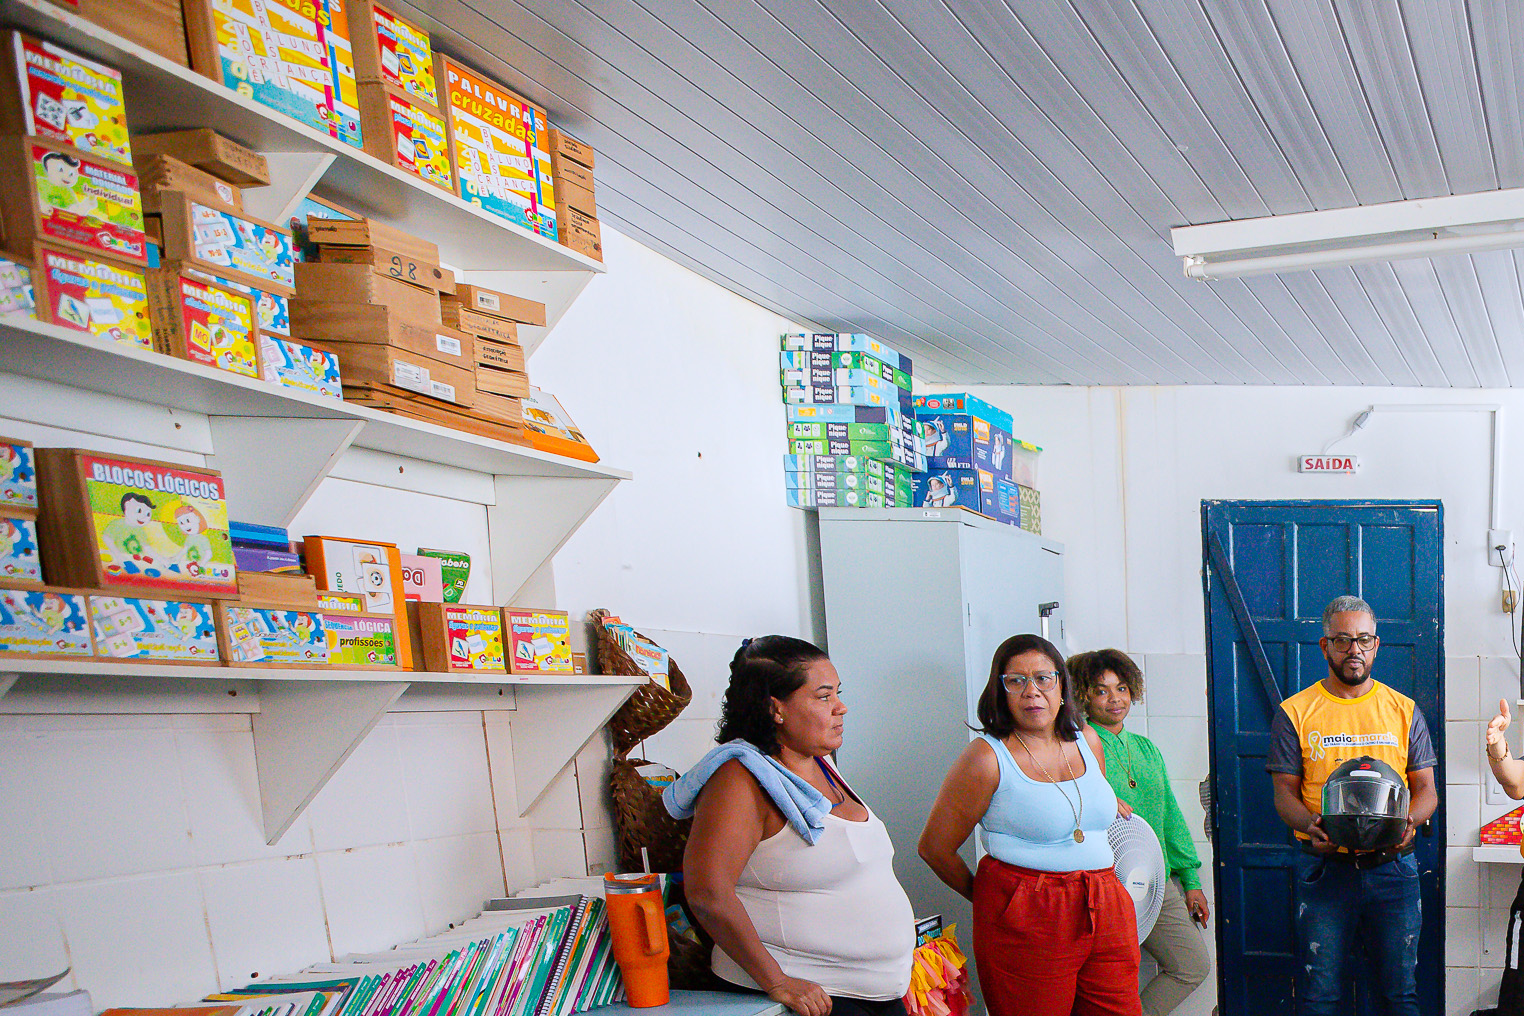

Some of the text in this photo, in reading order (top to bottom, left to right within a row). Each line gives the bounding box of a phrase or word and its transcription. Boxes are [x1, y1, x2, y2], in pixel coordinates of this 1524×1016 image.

[448, 70, 544, 131] PALAVRAS
[451, 91, 536, 144] cruzadas
[477, 173, 536, 192] CRIANÇA
[83, 184, 133, 205] individual
[814, 335, 833, 343] Pique
[815, 341, 832, 349] nique
[812, 352, 830, 360] Pique
[812, 358, 830, 366] nique
[812, 368, 831, 376] Pique
[814, 387, 833, 395] Pique
[815, 393, 833, 401] nique
[828, 424, 846, 432] Pique
[830, 441, 849, 449] Pique
[816, 456, 834, 464] Pique
[817, 473, 835, 481] Pique
[92, 463, 220, 500] BLOCOS LÓGICOS
[817, 479, 835, 487] nique
[817, 490, 835, 498] Pique
[318, 599, 358, 612] MÓRIA
[447, 612, 498, 622] MEMÓRIA
[511, 615, 566, 625] MEMÓRIA
[354, 619, 391, 633] LÓGICA
[340, 636, 383, 648] profissões
